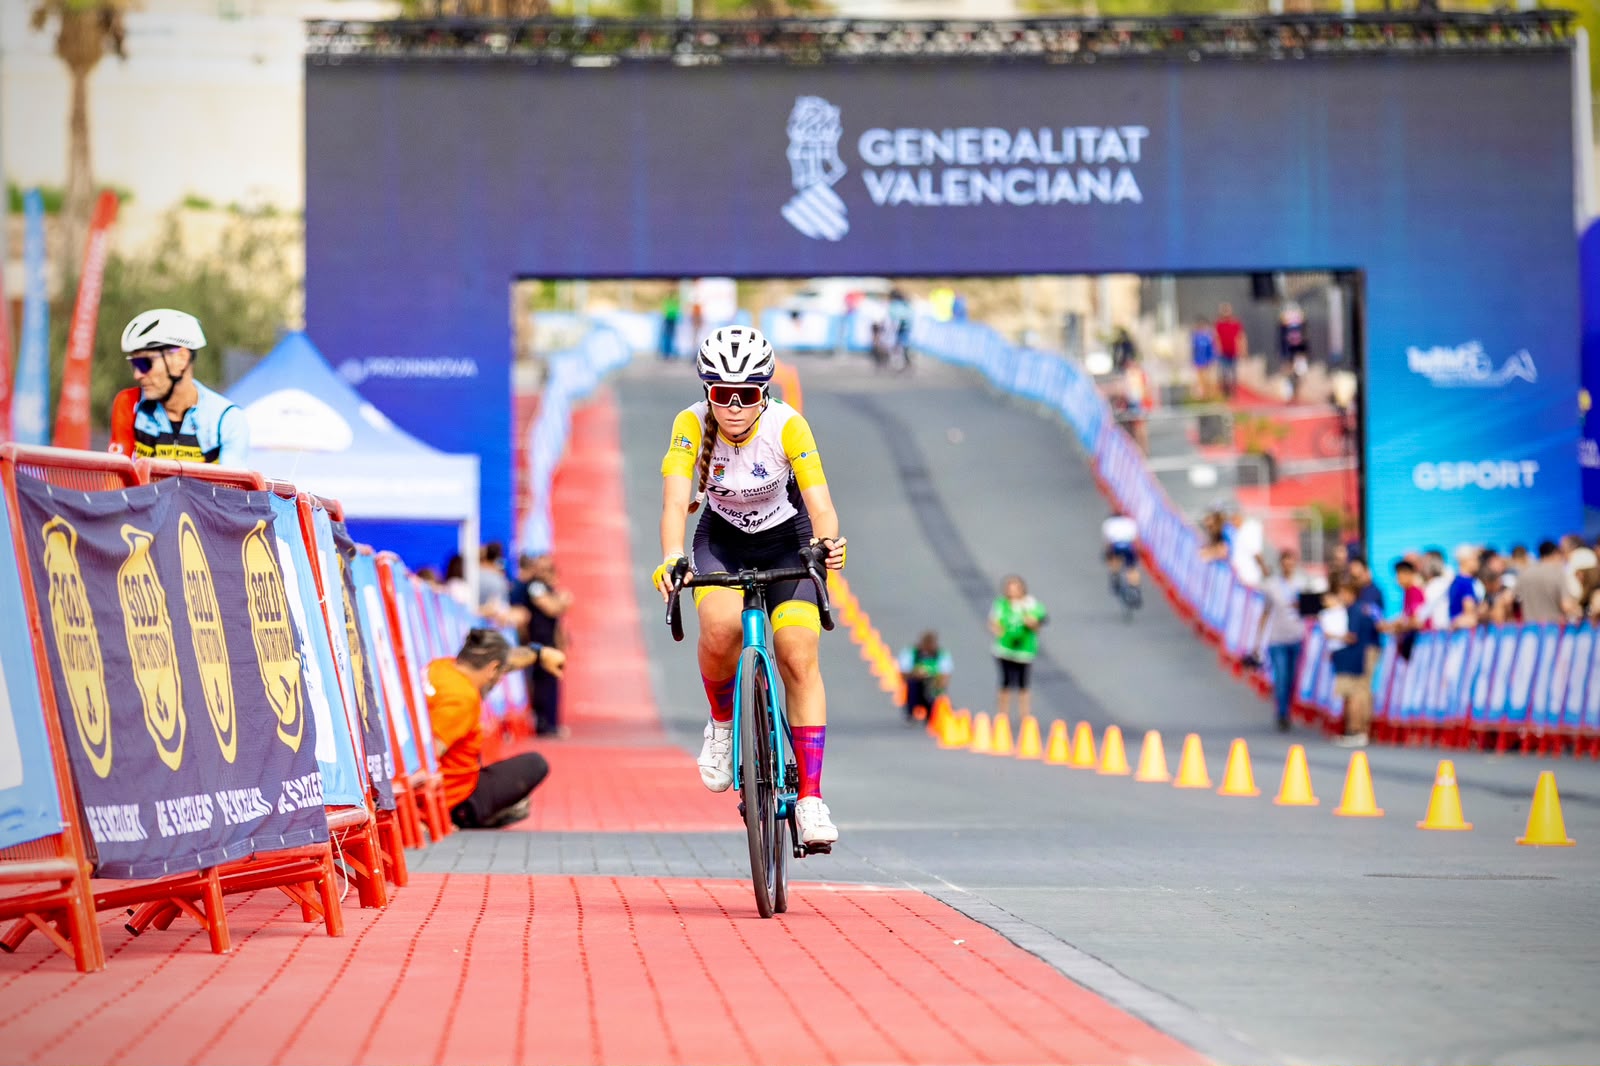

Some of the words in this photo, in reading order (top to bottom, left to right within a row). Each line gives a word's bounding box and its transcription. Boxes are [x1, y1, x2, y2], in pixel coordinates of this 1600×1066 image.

[858, 126, 1150, 166] GENERALITAT
[862, 167, 1143, 206] VALENCIANA
[741, 479, 780, 494] HYUNDAI
[1412, 459, 1540, 491] GSPORT
[124, 573, 159, 628] GOLD
[186, 569, 214, 622] GOLD
[251, 571, 282, 622] GOLD
